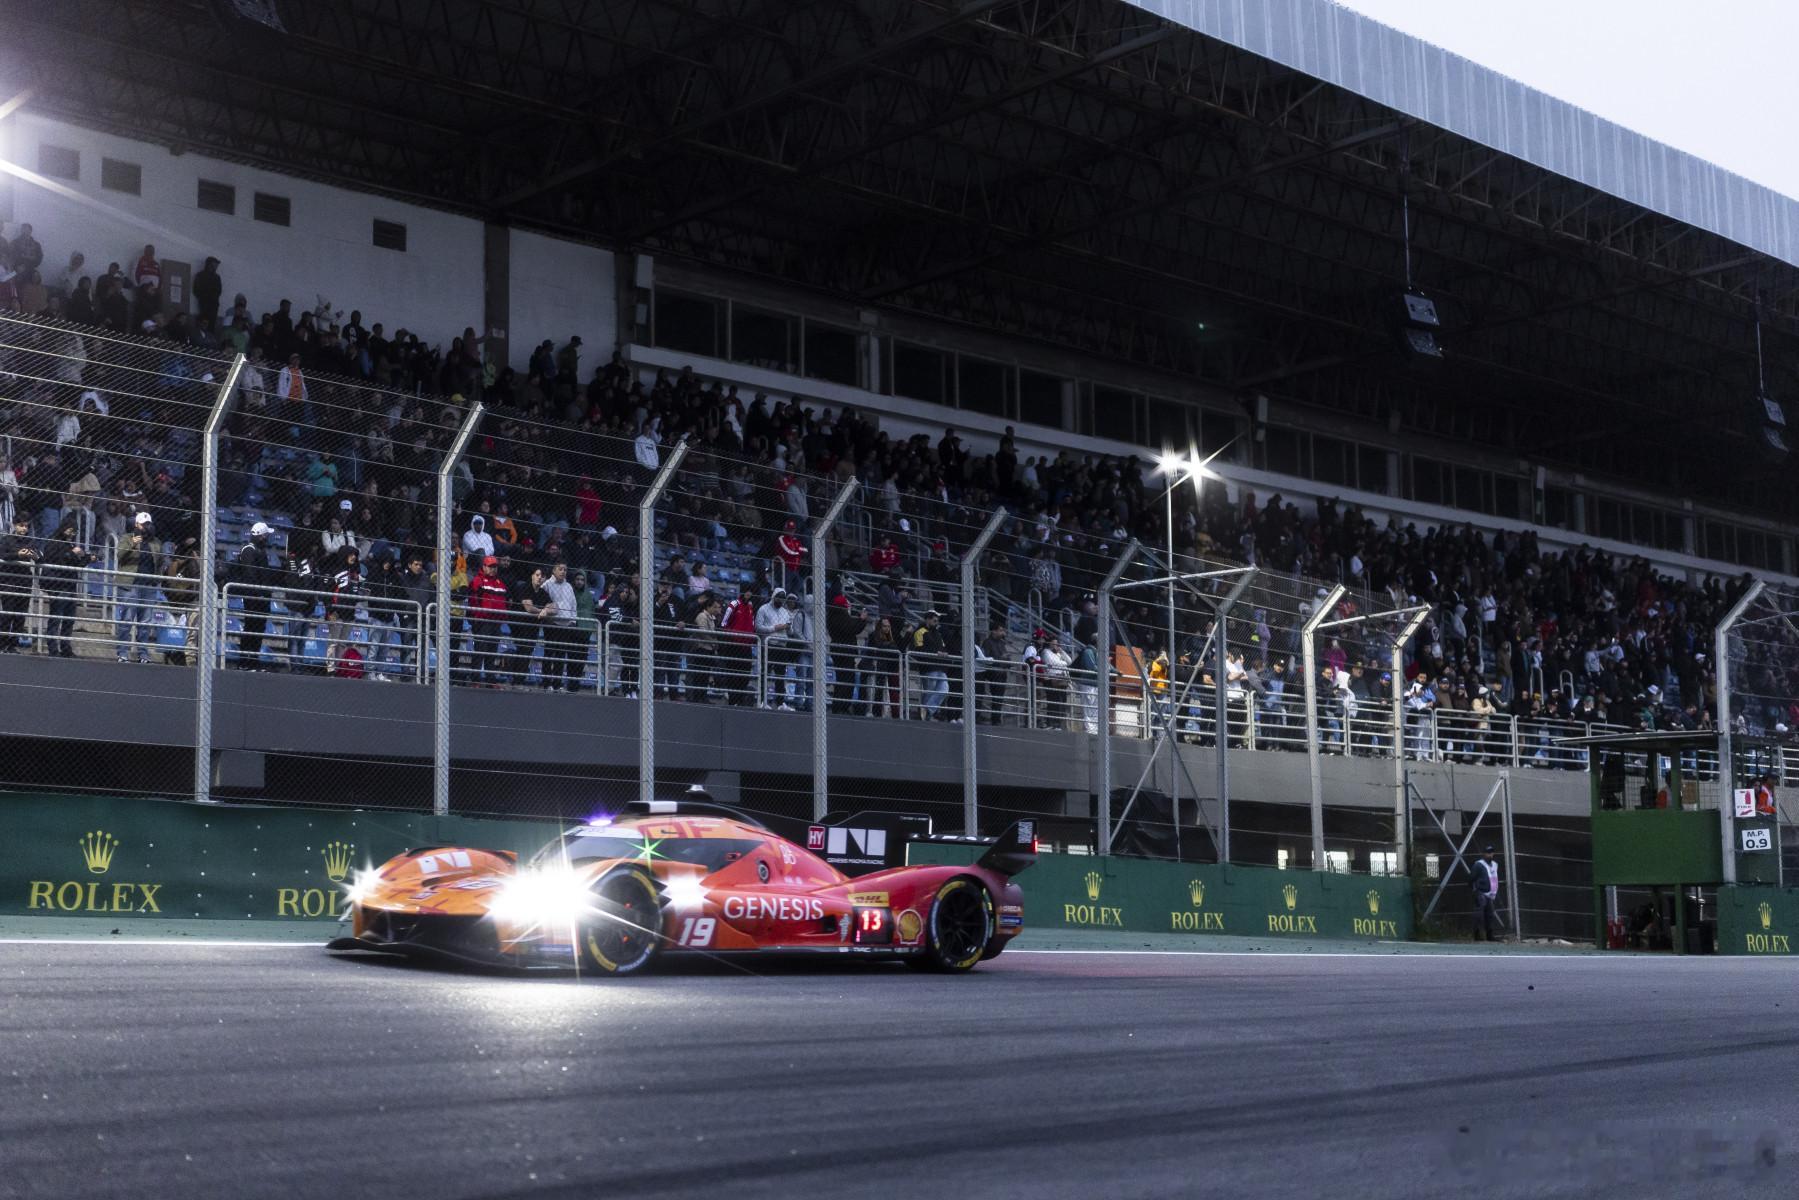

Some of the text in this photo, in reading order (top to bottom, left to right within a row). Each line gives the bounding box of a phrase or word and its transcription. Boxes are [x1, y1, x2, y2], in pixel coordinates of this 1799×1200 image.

[810, 831, 824, 845] HY
[1746, 838, 1768, 849] 0.9
[28, 880, 163, 913] ROLEX
[277, 888, 353, 918] ROL
[724, 896, 825, 921] GENESIS
[1064, 904, 1123, 926] ROLEX
[862, 910, 882, 931] 13
[1171, 912, 1224, 930] ROLEX
[1268, 914, 1318, 933] ROLEX
[1353, 918, 1398, 938] ROLEX
[678, 917, 716, 947] 19
[1746, 934, 1791, 953] ROLEX
